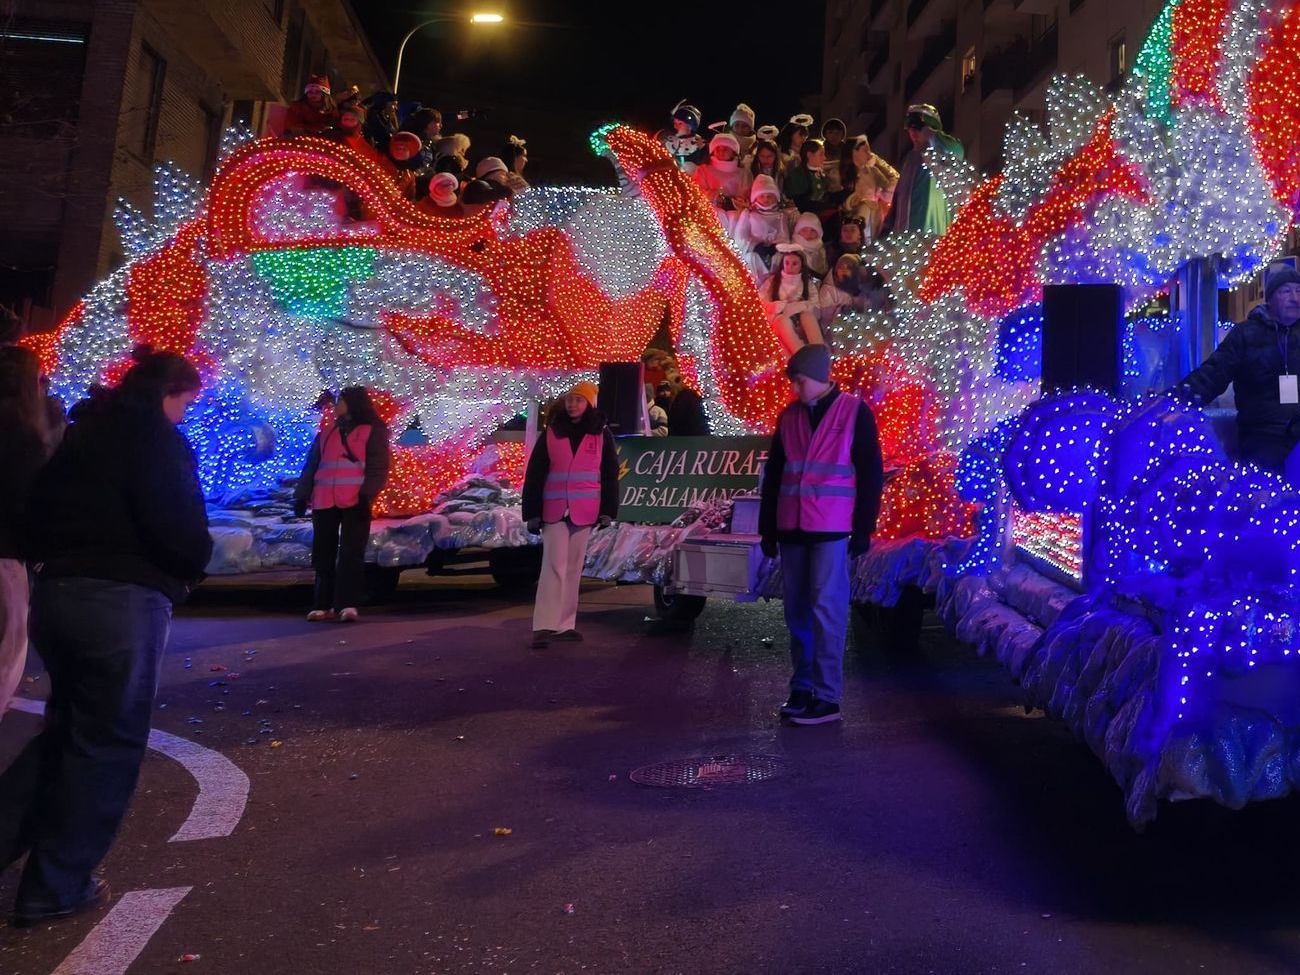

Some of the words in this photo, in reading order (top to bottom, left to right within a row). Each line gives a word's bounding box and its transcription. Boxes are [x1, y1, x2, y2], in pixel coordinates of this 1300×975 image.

[634, 449, 688, 483] CAJA
[620, 486, 649, 507] DE
[646, 486, 753, 508] SALAMAN
